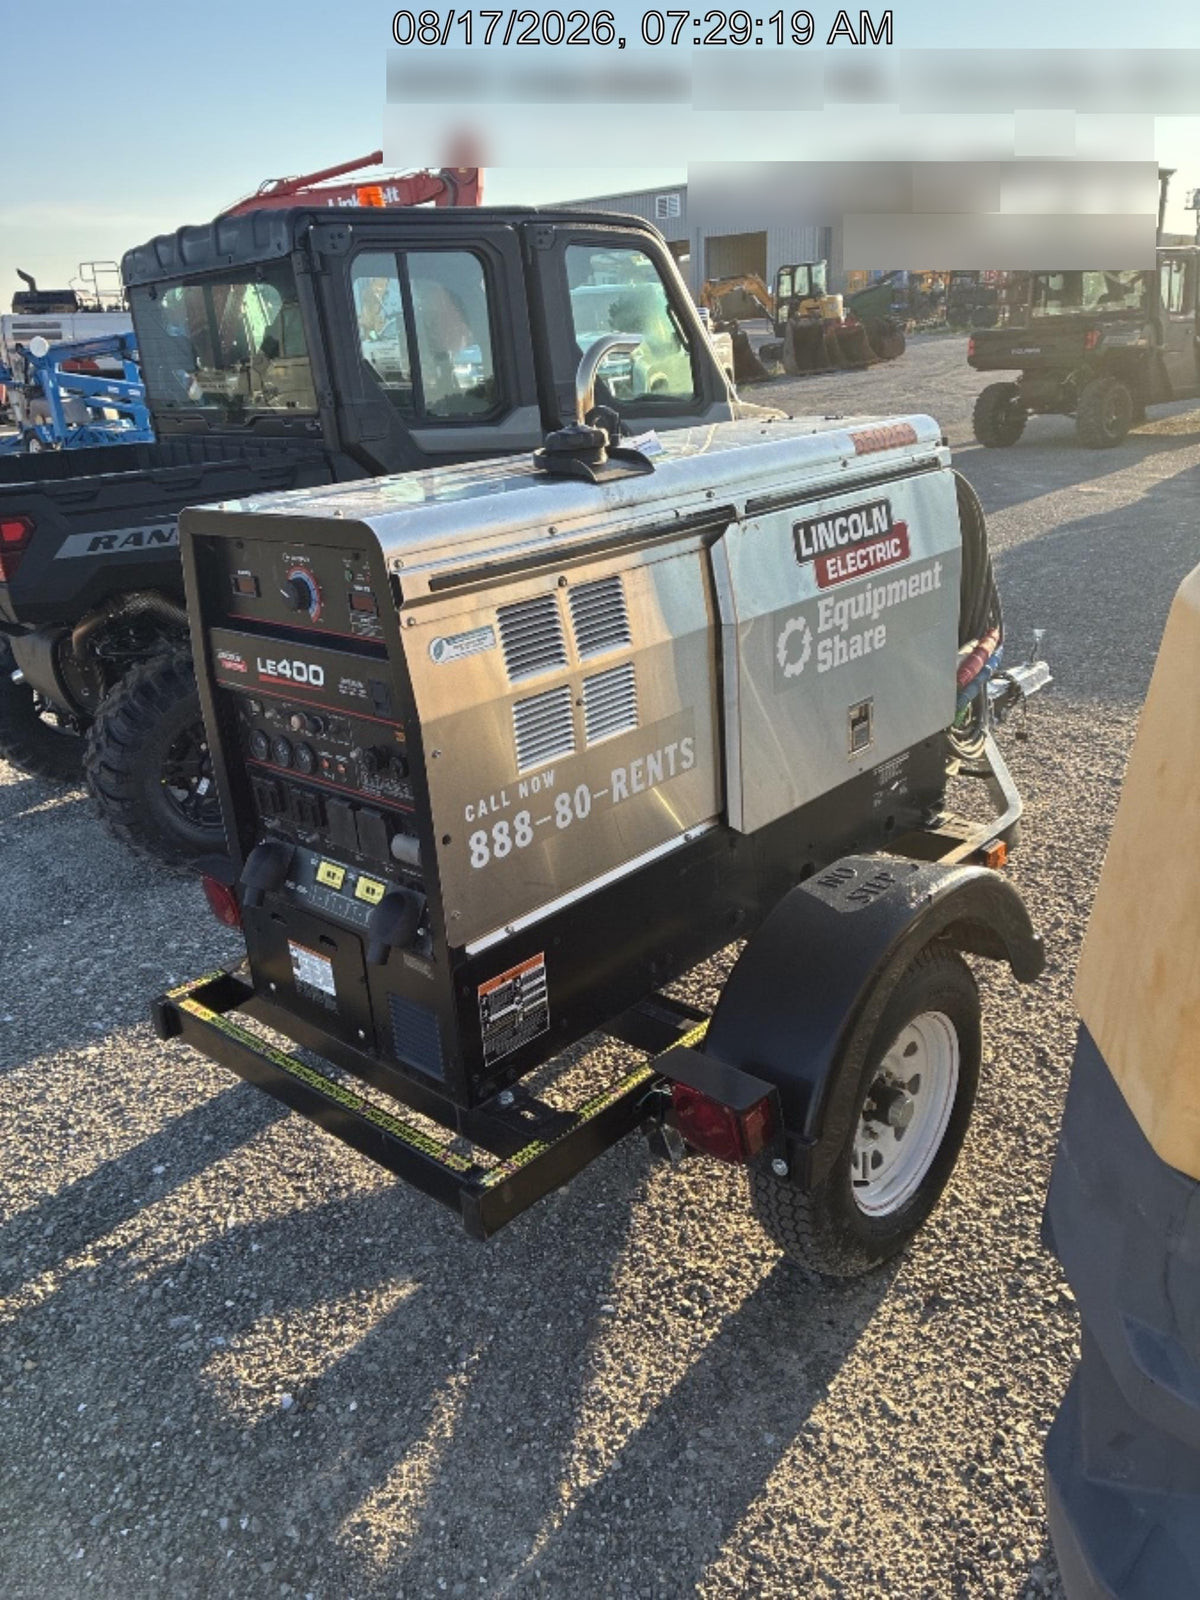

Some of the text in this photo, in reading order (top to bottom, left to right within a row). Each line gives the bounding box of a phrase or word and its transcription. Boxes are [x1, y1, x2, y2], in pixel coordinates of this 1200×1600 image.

[86, 526, 179, 552] RAN
[798, 505, 889, 558] LINCOLN
[826, 538, 902, 580] ELECTRIC
[817, 561, 943, 633] Equipment
[257, 657, 324, 687] LE400
[817, 624, 887, 673] Share
[465, 770, 556, 822] CALL NOW
[469, 737, 695, 868] 888-80-RENTS
